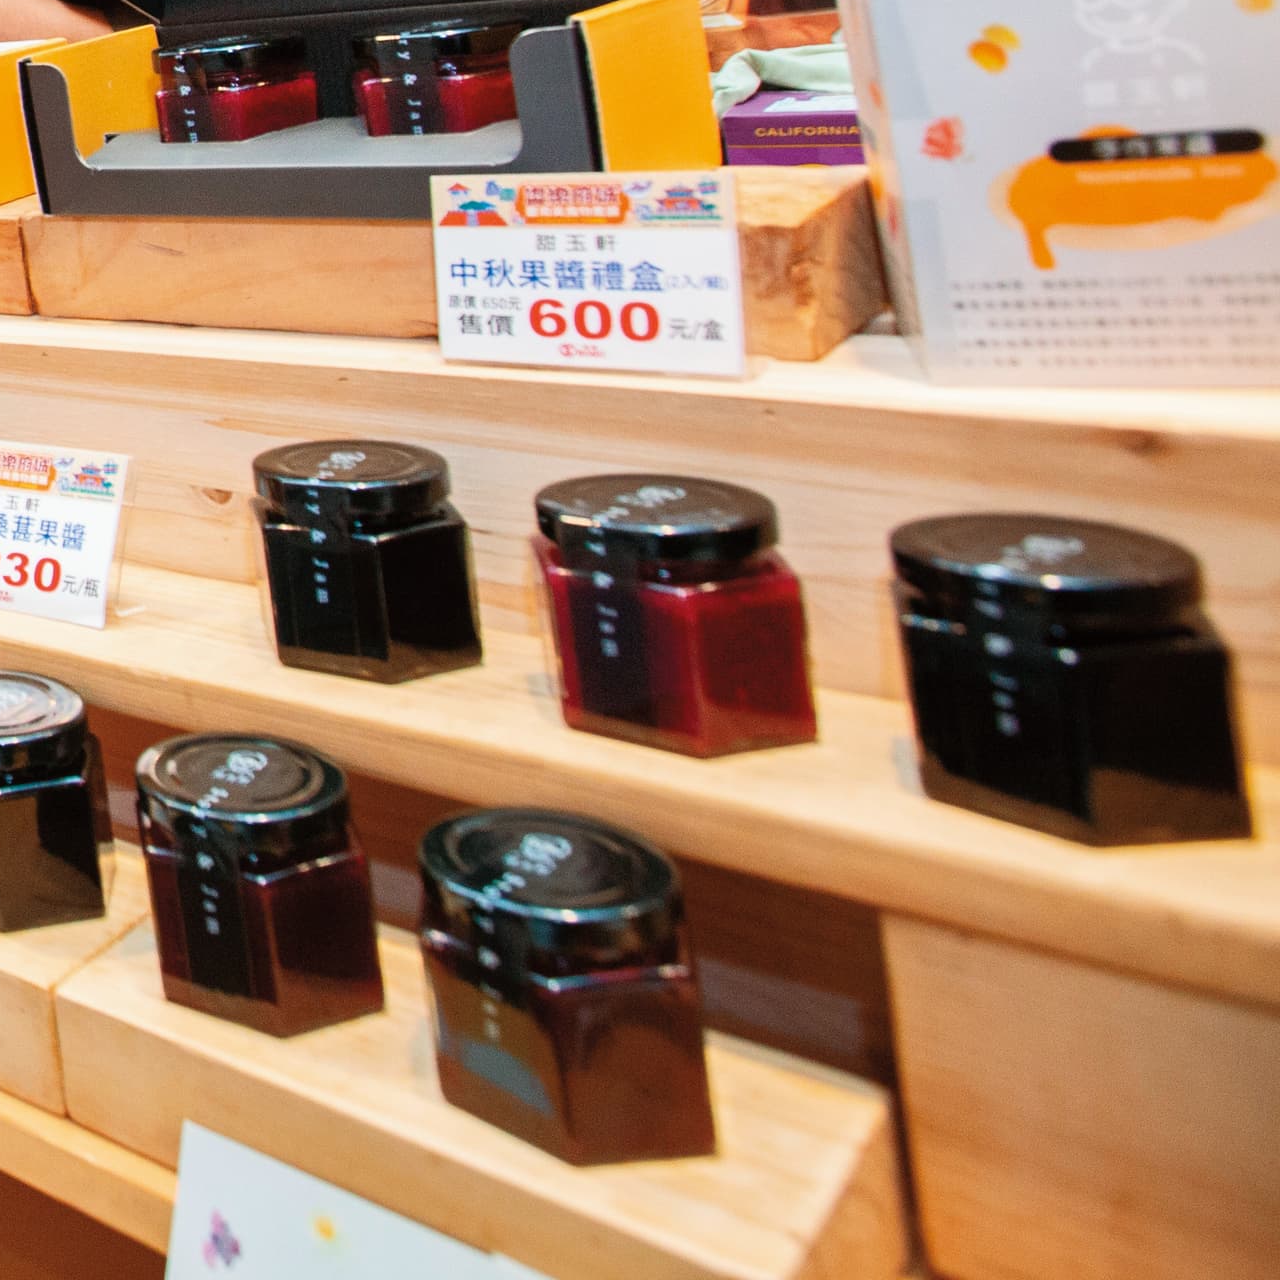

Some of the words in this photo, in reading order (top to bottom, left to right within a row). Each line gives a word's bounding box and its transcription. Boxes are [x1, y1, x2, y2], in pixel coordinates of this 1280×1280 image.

[449, 258, 664, 292] 中秋果醬禮盒
[459, 314, 515, 337] 售價
[529, 298, 661, 342] 600
[312, 557, 330, 604] Jam
